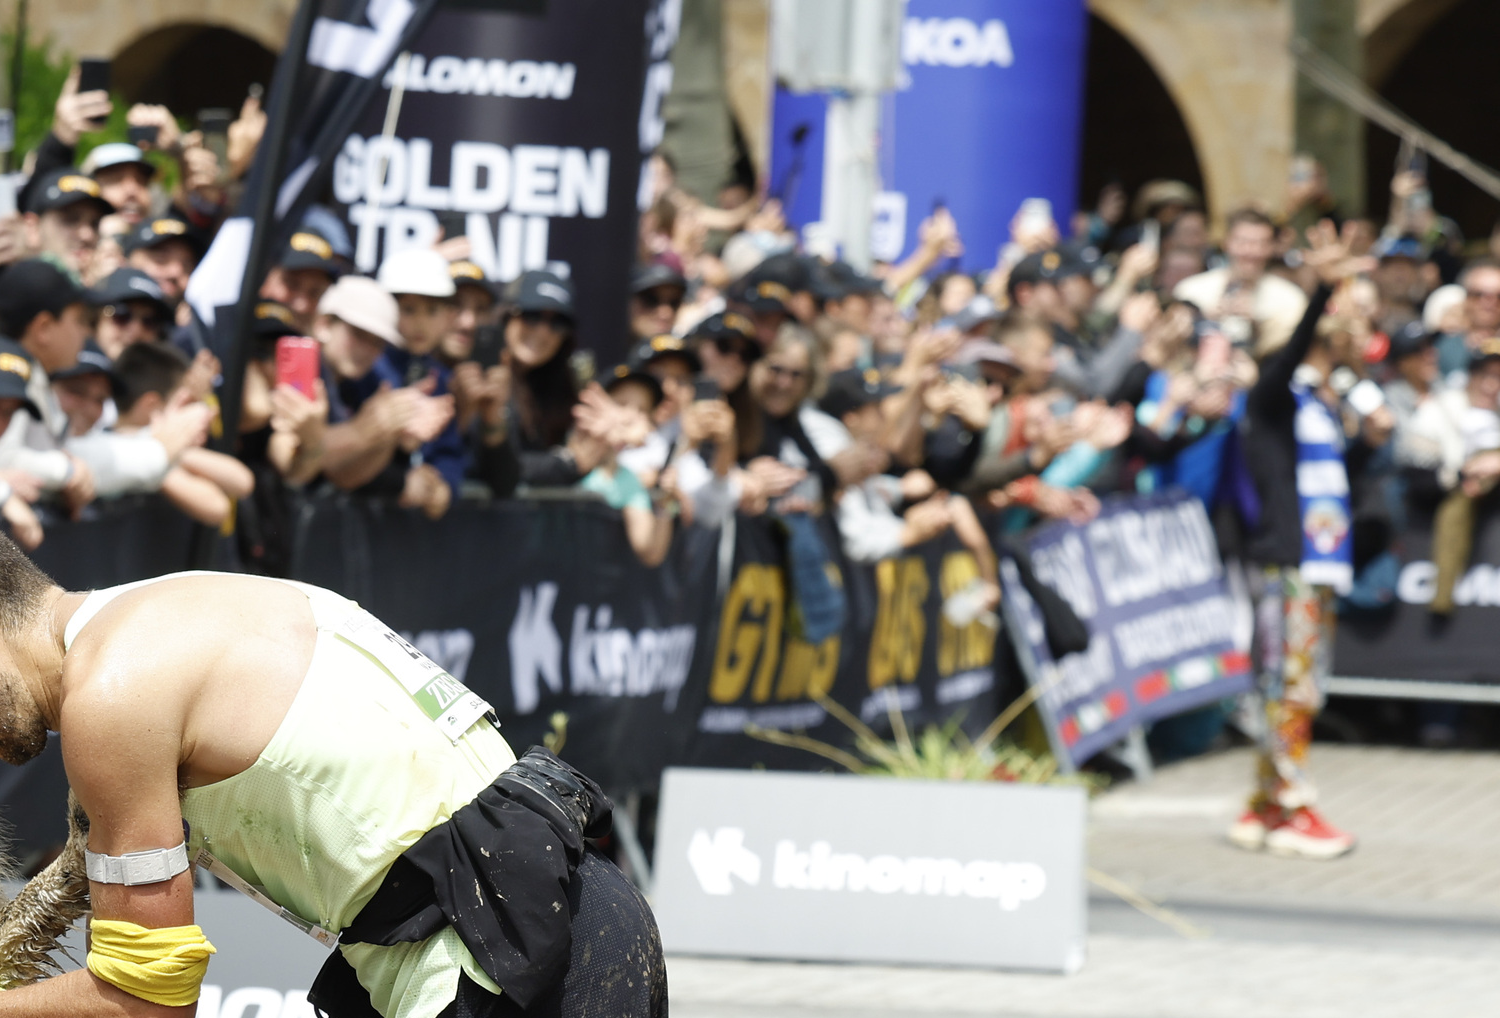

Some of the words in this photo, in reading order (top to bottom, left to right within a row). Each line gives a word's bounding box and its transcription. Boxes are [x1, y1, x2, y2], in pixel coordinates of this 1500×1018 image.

[382, 53, 577, 100] ALOMON
[333, 133, 611, 219] GOLDEN
[772, 838, 1048, 912] kinomap
